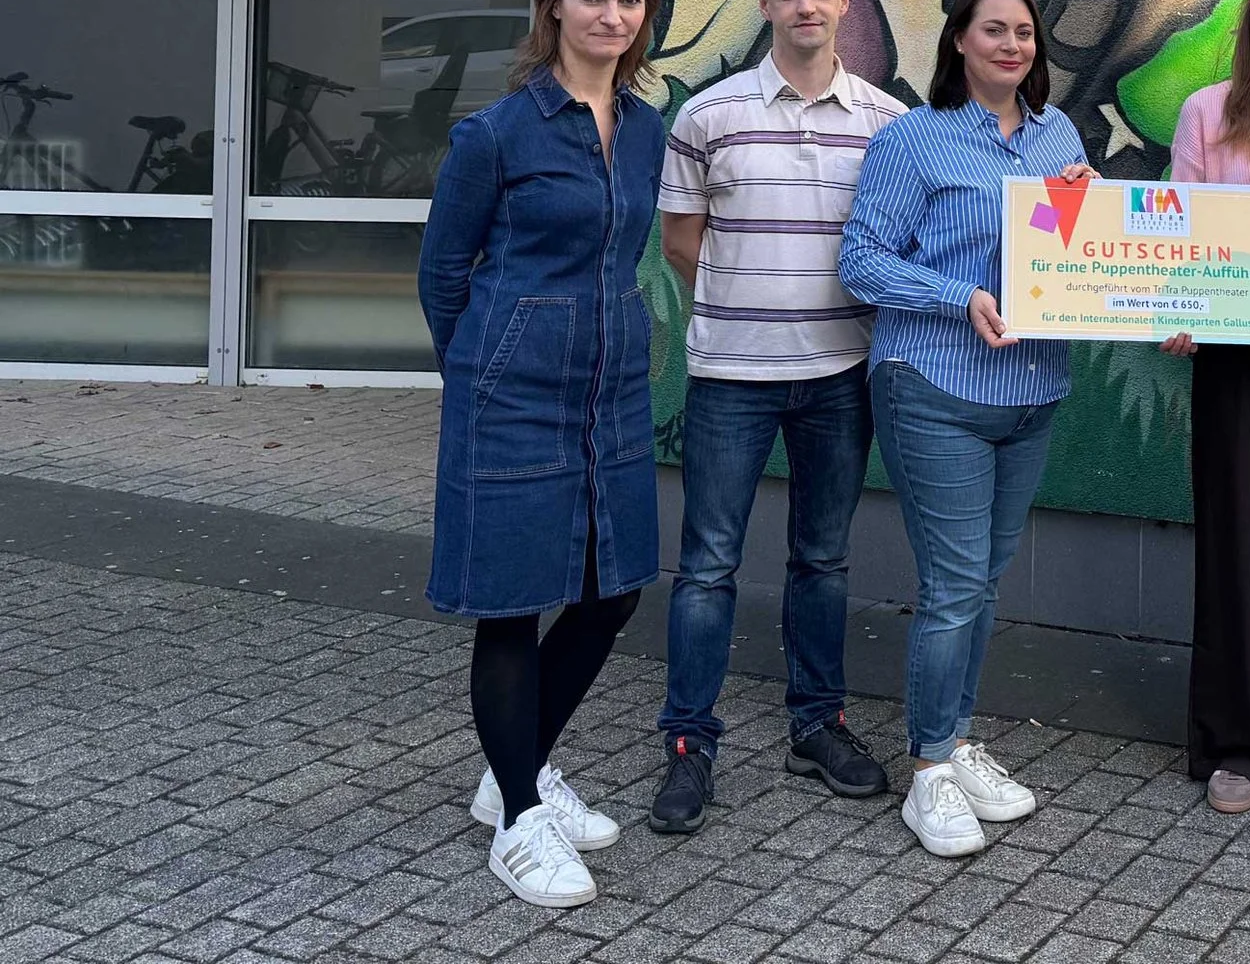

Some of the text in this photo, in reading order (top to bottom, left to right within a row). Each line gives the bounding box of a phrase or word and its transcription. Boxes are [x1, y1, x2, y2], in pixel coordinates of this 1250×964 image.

[1083, 241, 1232, 262] GUTSCHEIN
[1031, 259, 1052, 272] für
[1056, 260, 1087, 273] eine
[1066, 282, 1127, 294] durchgeführt
[1130, 286, 1151, 294] vom
[1181, 286, 1249, 297] Puppentheater
[1112, 297, 1205, 311] im Wert von € 650,-
[1041, 312, 1056, 322] für
[1059, 313, 1077, 323] den
[1080, 313, 1155, 325] Internationalen
[1157, 315, 1221, 328] Kindergarten
